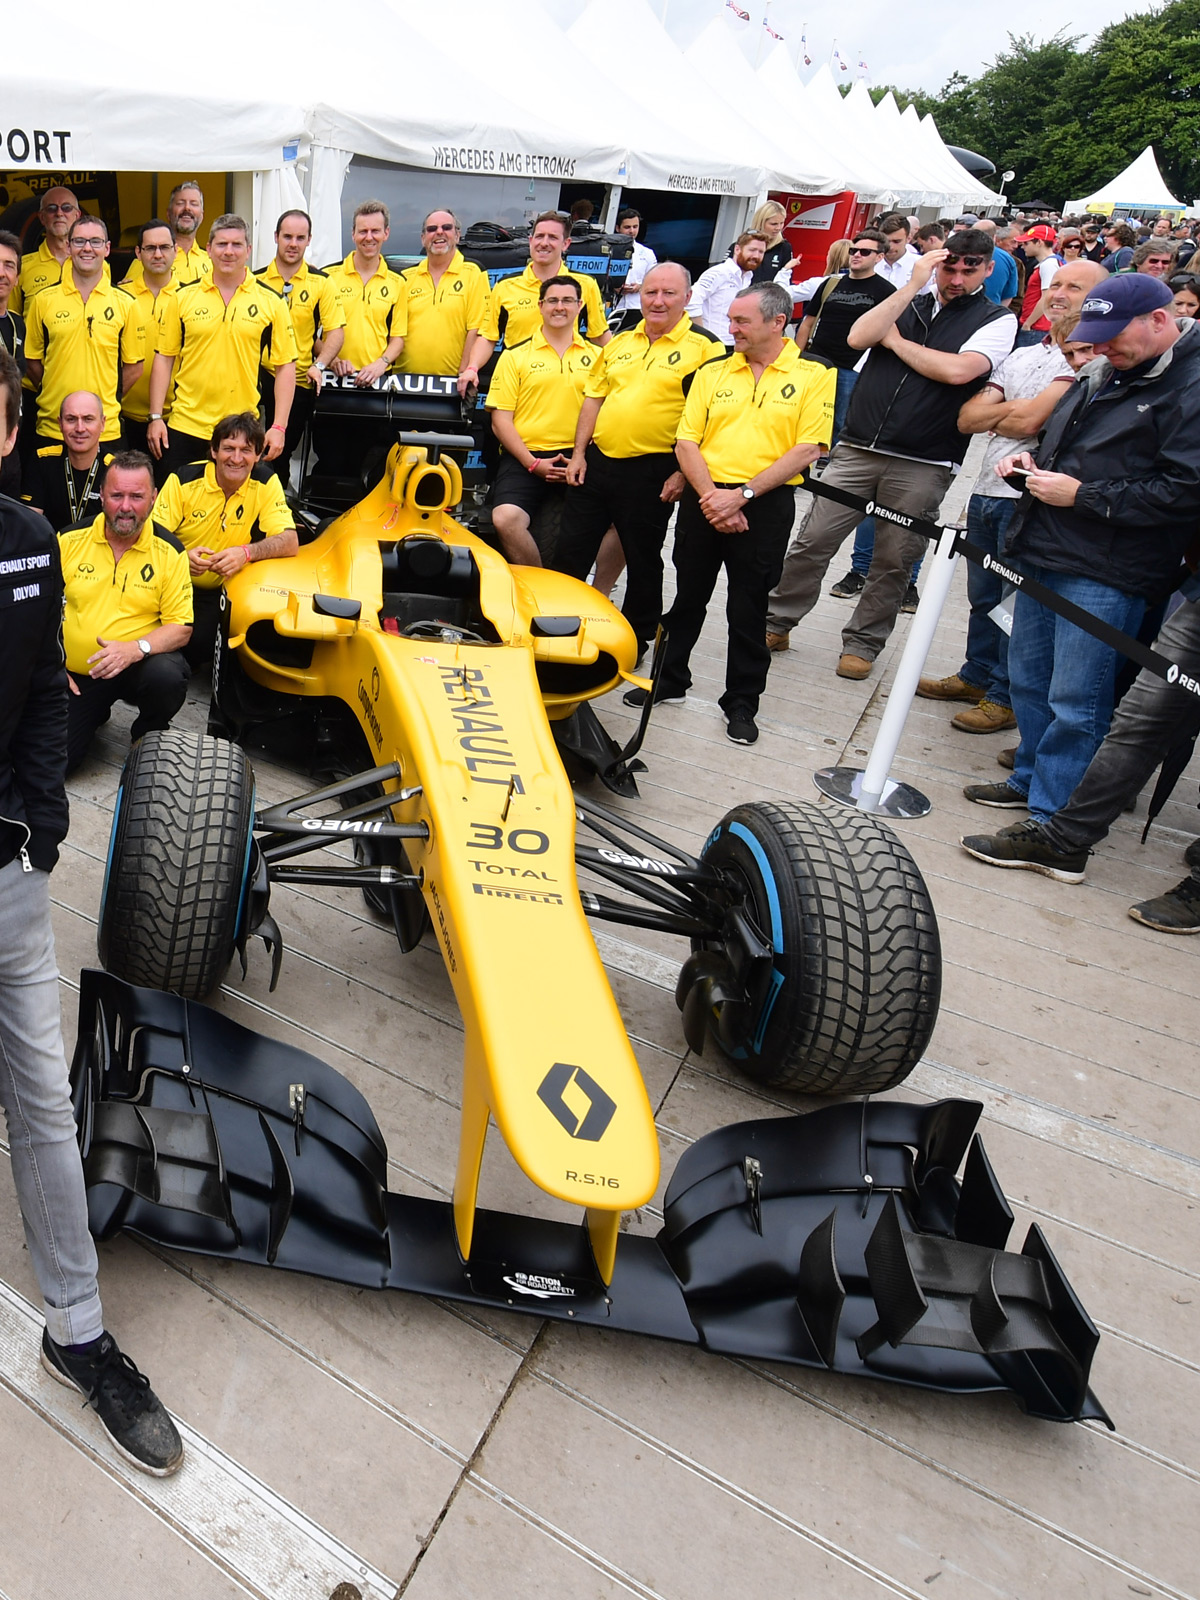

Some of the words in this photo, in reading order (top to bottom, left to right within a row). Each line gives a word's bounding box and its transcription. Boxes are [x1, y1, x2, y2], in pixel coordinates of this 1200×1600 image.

[432, 146, 495, 170] MERCEDES
[499, 152, 522, 172] AMG
[525, 154, 576, 177] PETRONAS
[29, 172, 97, 189] RENAUL
[667, 174, 698, 190] MERCEDES
[699, 177, 711, 191] AMG
[711, 178, 736, 193] PETRONAS
[577, 261, 604, 270] FRONT
[609, 263, 627, 273] RONT
[873, 506, 913, 527] RENAULT
[26, 554, 51, 570] SPORT
[990, 561, 1024, 586] RENAULT
[12, 583, 40, 602] JOLYON
[438, 665, 526, 795] RENAULT
[466, 822, 550, 855] 30
[468, 860, 558, 882] TOTAL
[472, 882, 564, 905] PIRELLI
[566, 1170, 620, 1189] R.S.16
[527, 1281, 548, 1290] ROAD
[548, 1284, 575, 1295] SAFETY
[528, 1275, 561, 1287] ACTION
